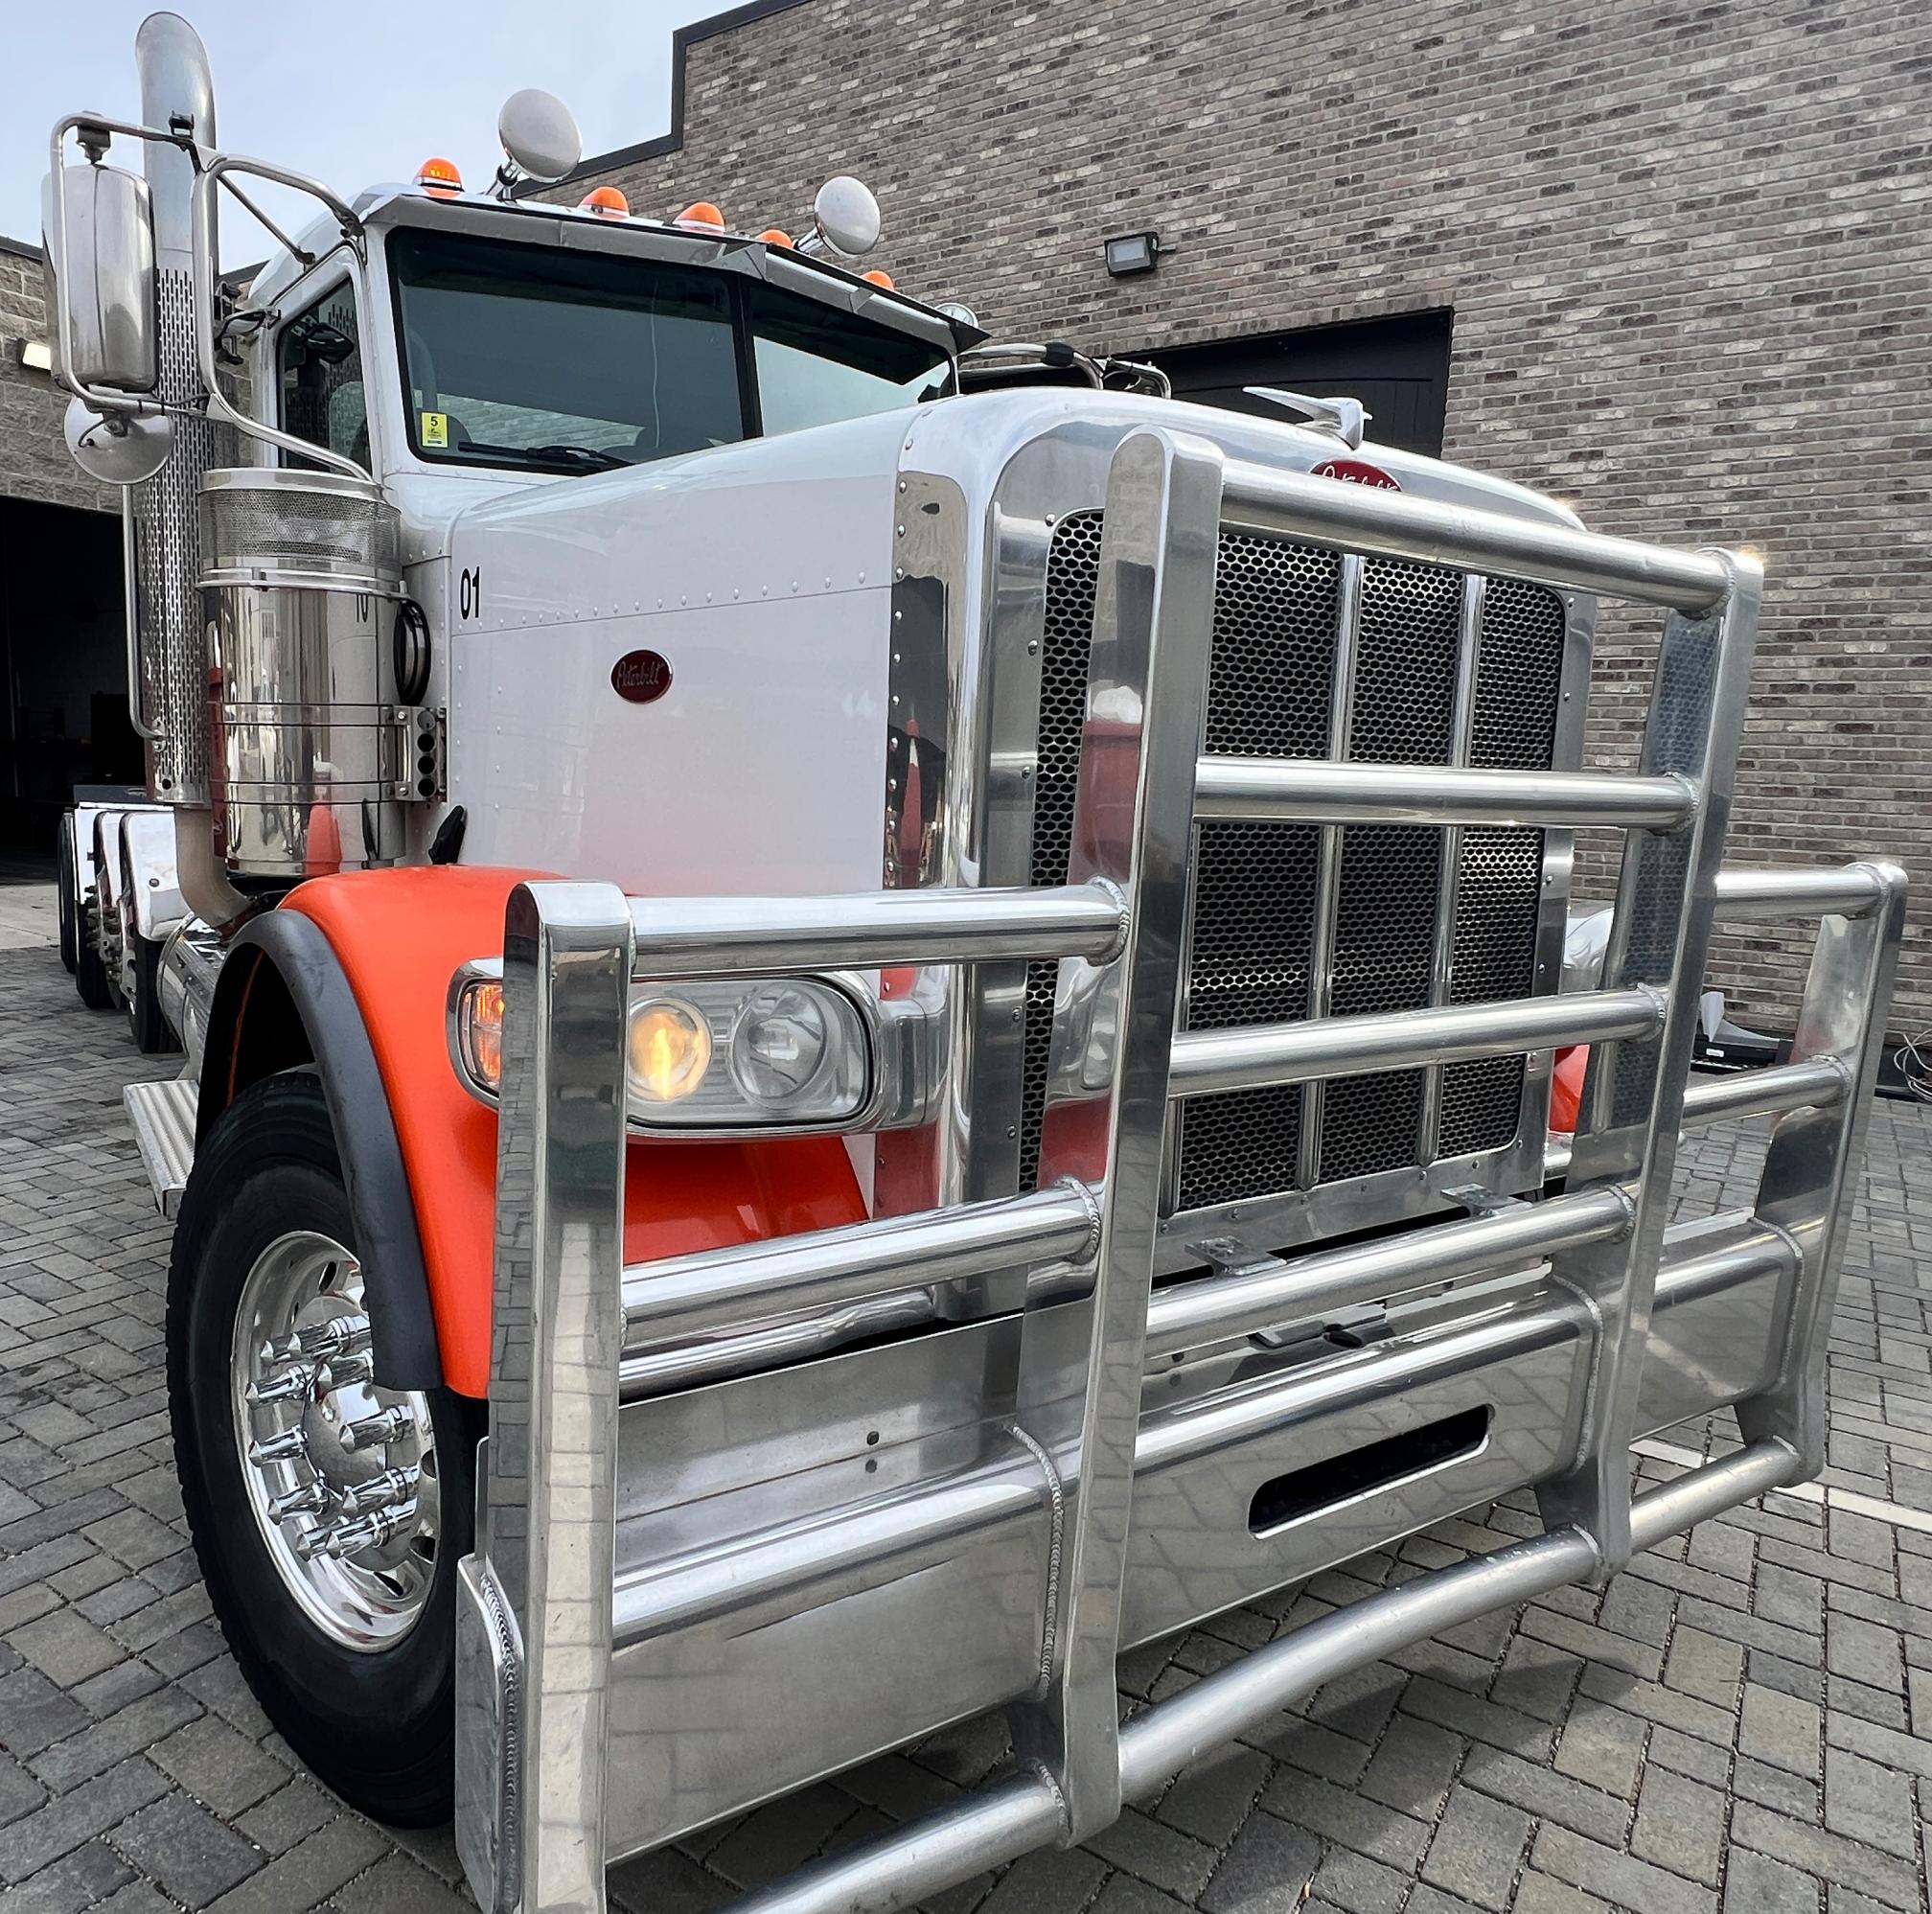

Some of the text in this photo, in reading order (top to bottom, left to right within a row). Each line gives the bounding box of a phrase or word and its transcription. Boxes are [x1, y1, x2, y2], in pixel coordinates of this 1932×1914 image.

[430, 415, 438, 427] 5
[460, 566, 480, 620] 01
[616, 659, 666, 690] Peterbilt
